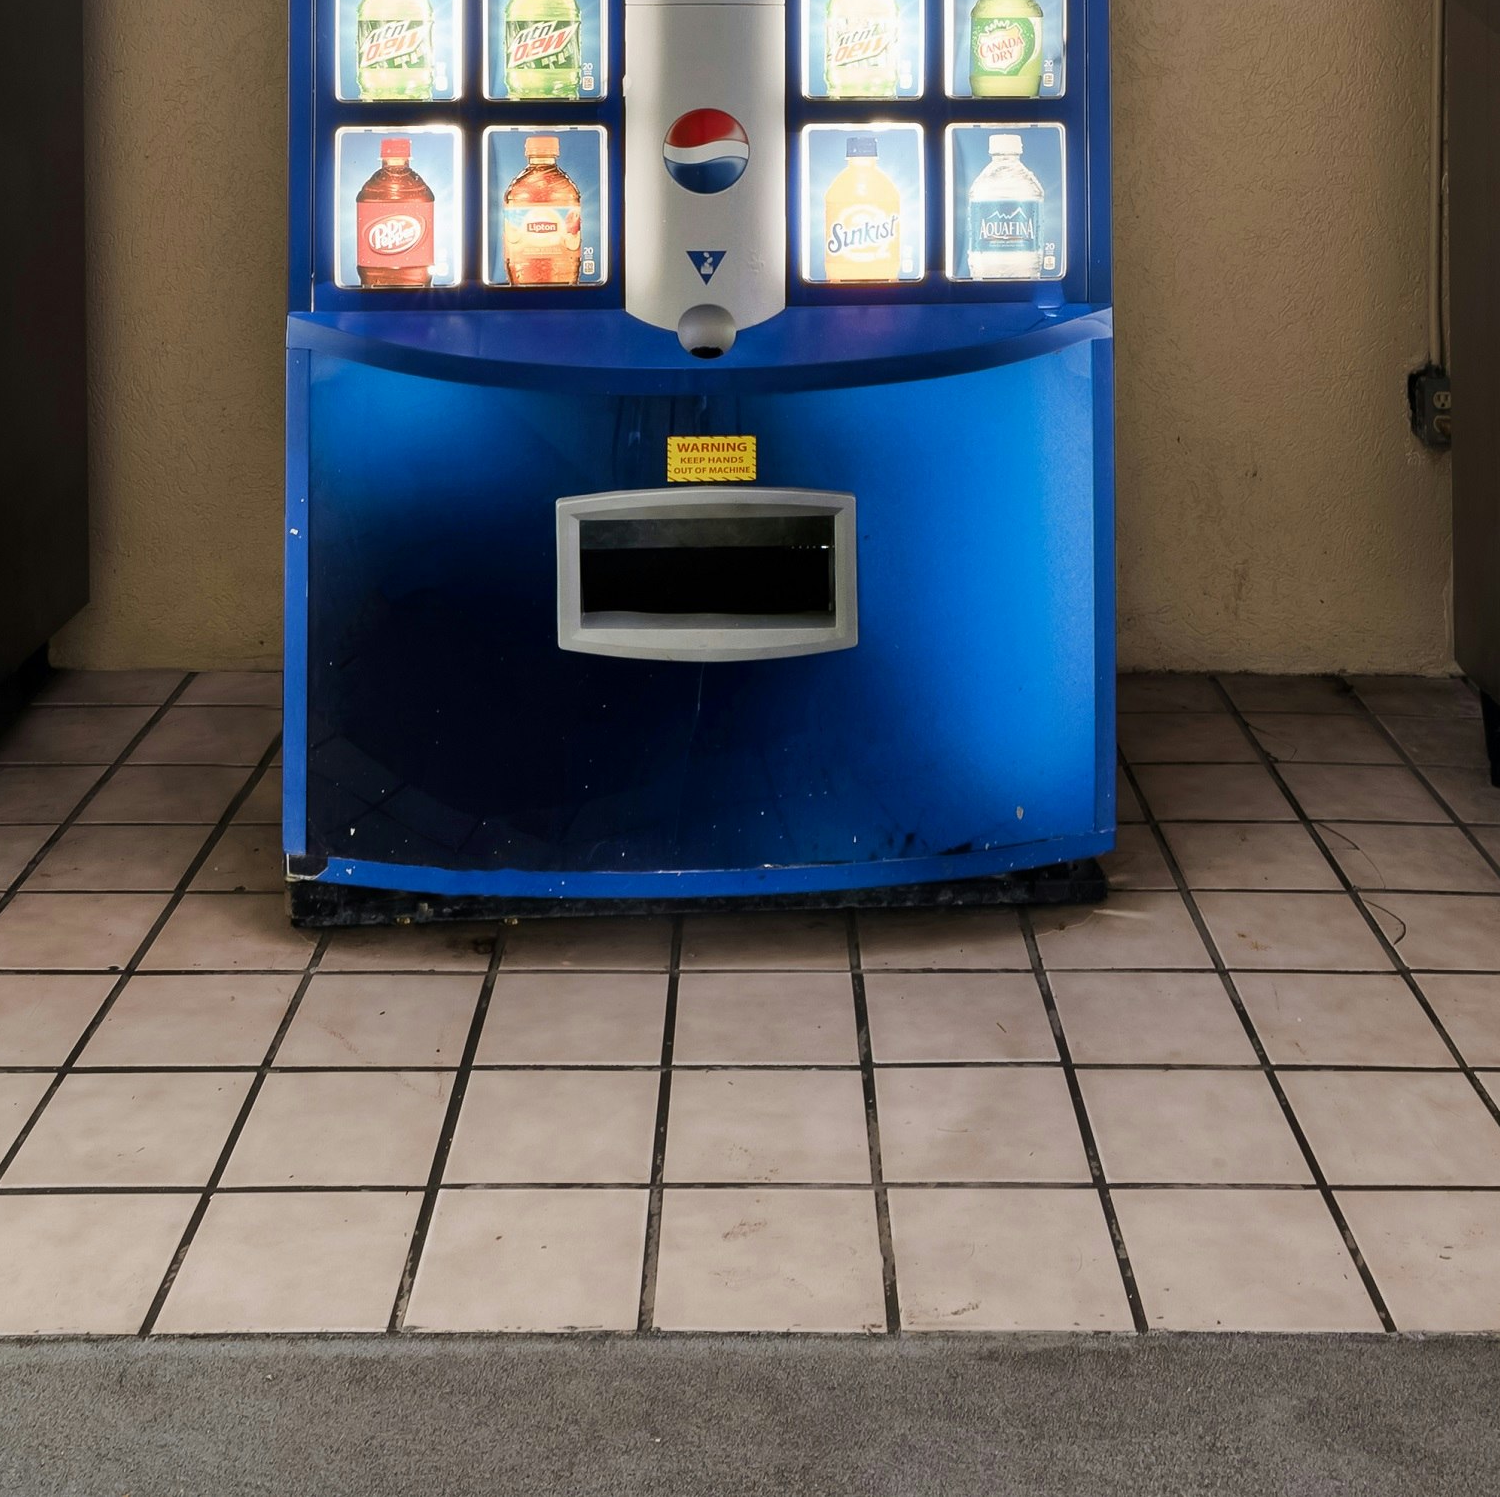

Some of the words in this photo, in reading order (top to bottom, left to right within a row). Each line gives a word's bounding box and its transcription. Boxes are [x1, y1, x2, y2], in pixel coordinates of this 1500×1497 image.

[980, 37, 1024, 58] CANADA
[992, 49, 1014, 63] DRY
[373, 223, 416, 250] Pepper
[828, 215, 899, 253] Sunkist
[980, 218, 1034, 240] AQUAFINA
[1045, 242, 1055, 250] 20
[677, 442, 747, 453] WARNING
